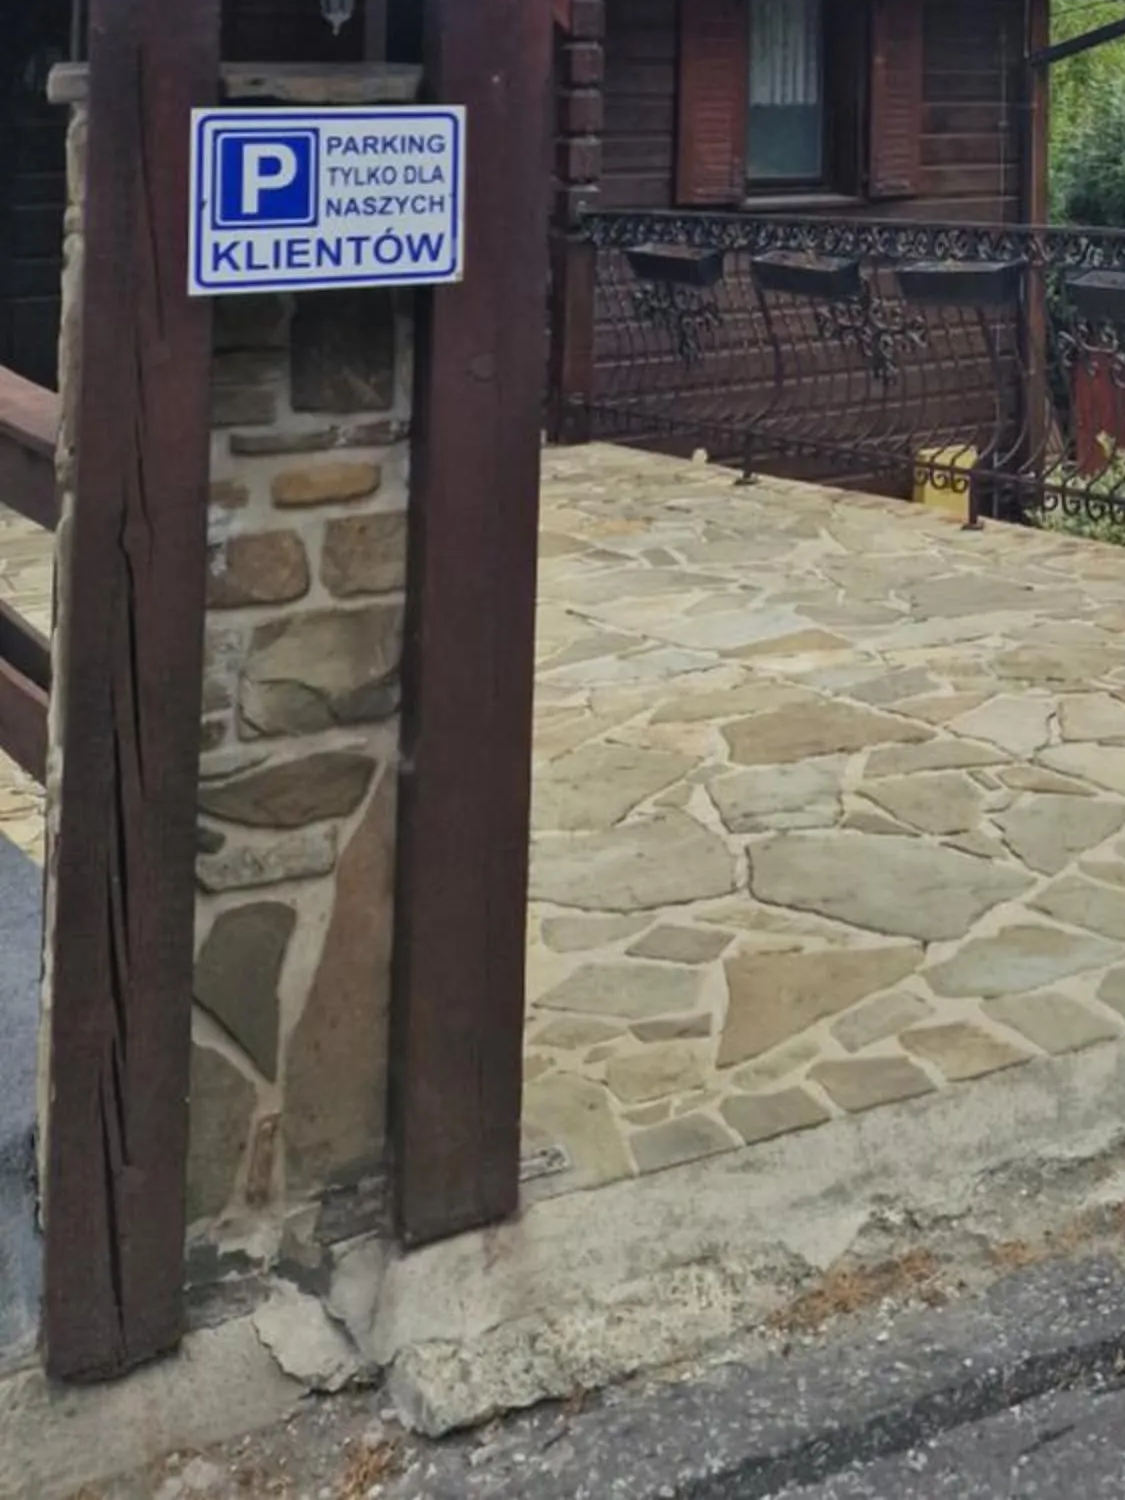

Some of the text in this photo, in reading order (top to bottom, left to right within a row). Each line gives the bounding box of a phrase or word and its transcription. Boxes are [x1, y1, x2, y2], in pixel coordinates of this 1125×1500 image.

[326, 134, 446, 156] PARKING
[241, 143, 298, 215] P
[327, 164, 446, 186] TYLKO DLA
[325, 195, 446, 218] NASZYCH
[211, 227, 446, 273] KLIENTÓW
